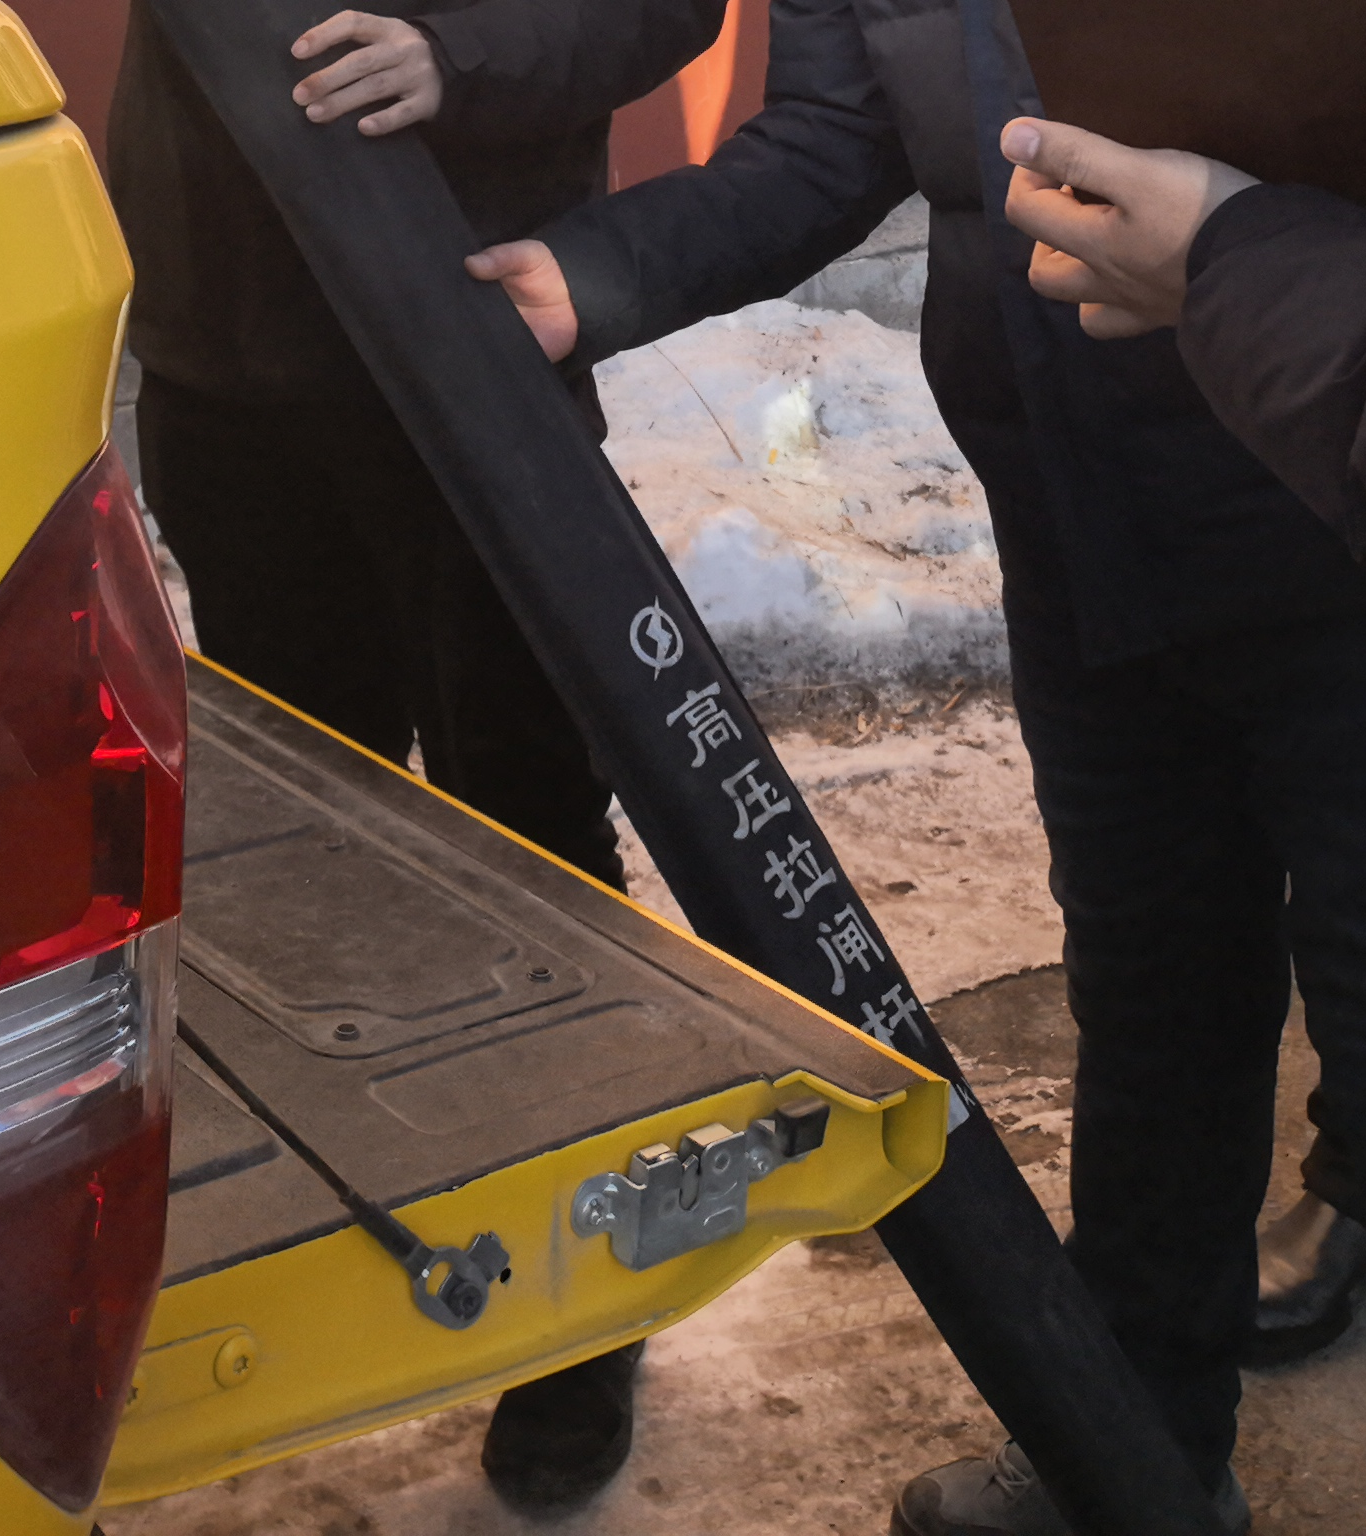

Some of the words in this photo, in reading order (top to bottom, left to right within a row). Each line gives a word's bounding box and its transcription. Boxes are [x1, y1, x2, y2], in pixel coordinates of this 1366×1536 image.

[666, 681, 927, 1050] 高压拉闸杆
